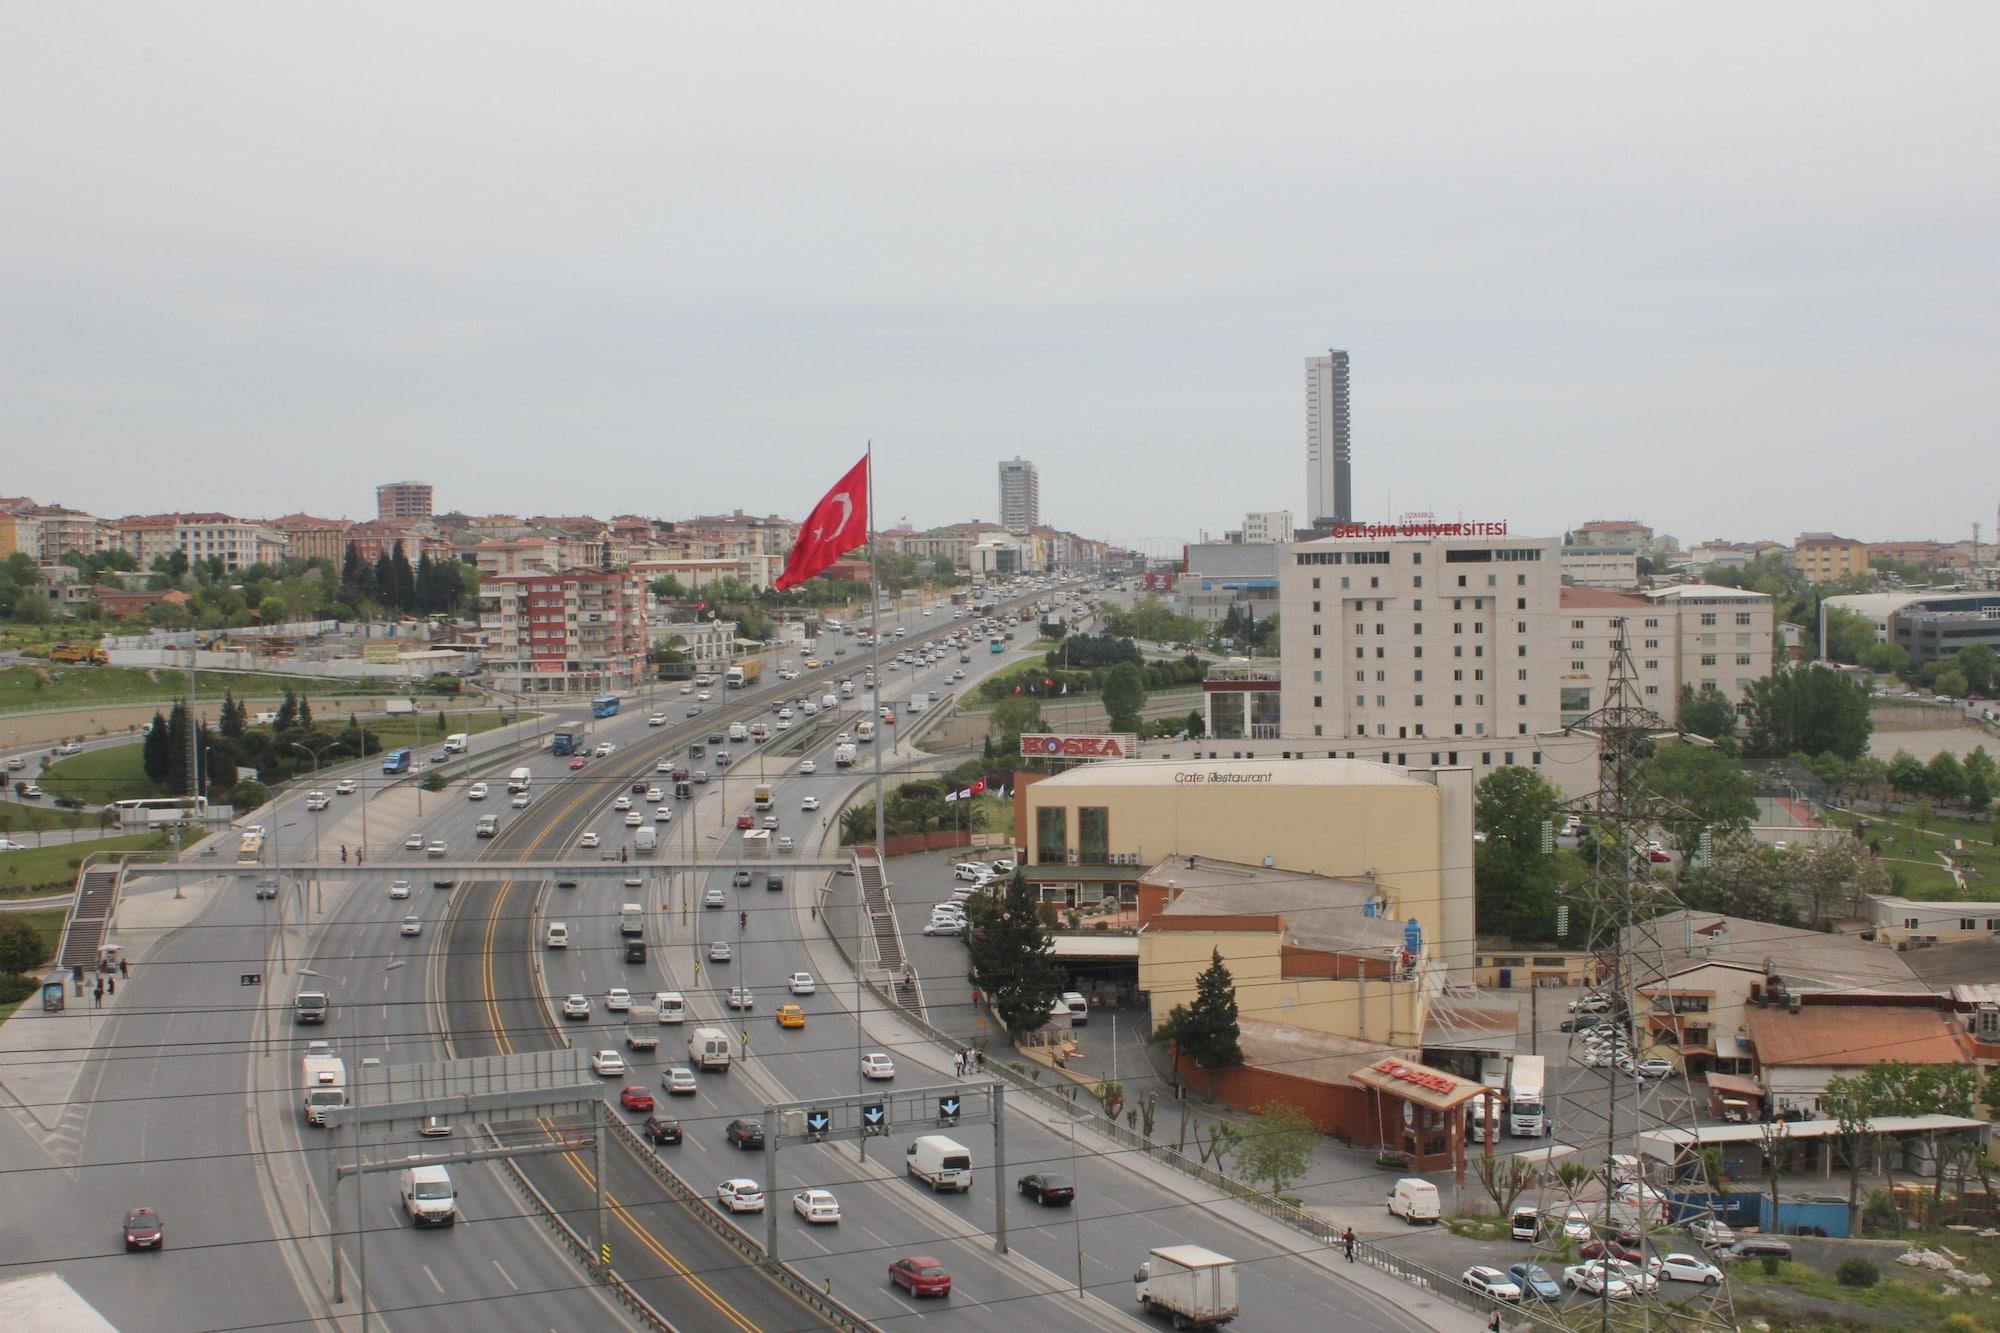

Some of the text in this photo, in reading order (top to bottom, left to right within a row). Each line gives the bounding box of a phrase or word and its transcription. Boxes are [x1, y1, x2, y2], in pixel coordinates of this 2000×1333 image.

[1402, 519, 1507, 537] ÜNİVERSİTESİ
[1022, 737, 1123, 756] KOSKA
[1174, 771, 1272, 785] Cafe Restaurant
[1374, 1062, 1457, 1095] KOSKA
